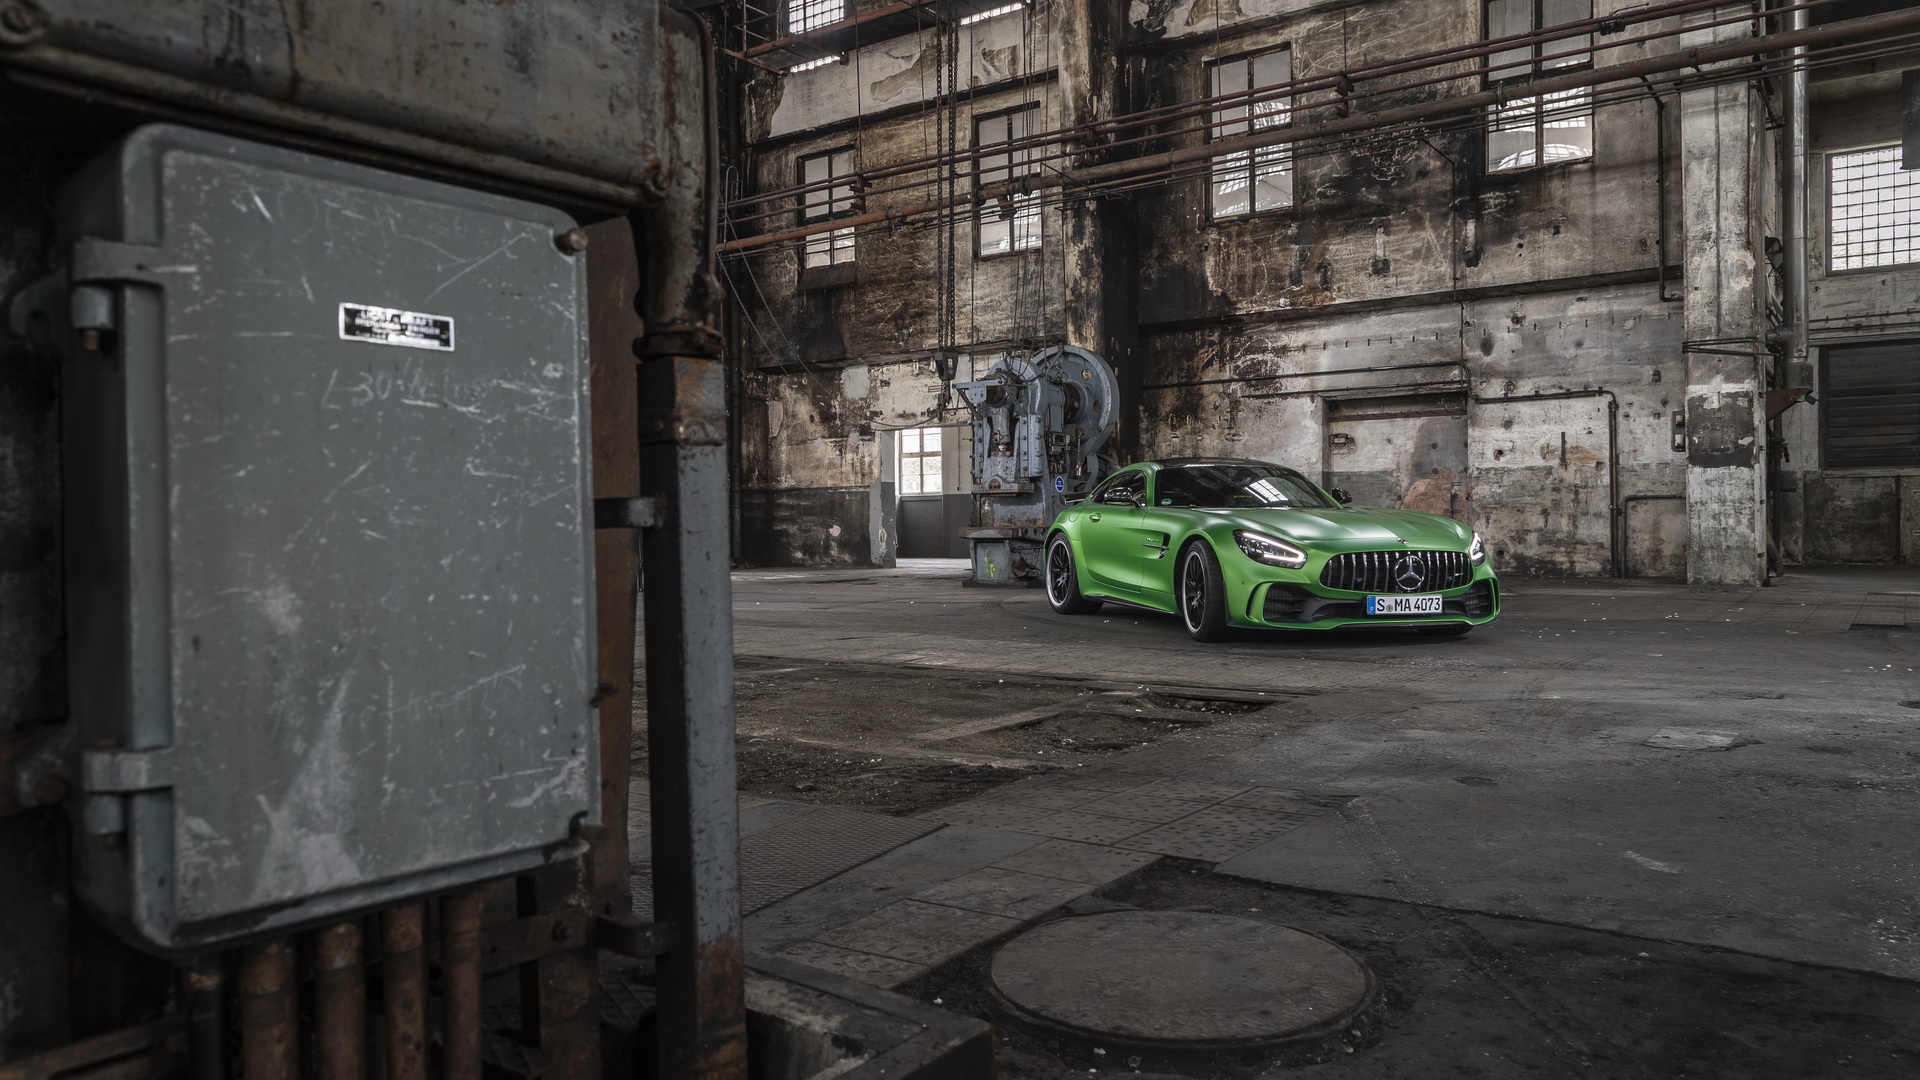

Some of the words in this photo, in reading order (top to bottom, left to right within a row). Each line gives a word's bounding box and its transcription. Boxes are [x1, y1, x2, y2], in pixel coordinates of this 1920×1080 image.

[1377, 599, 1385, 612] S
[1394, 598, 1411, 612] MA
[1414, 598, 1440, 611] 4073
